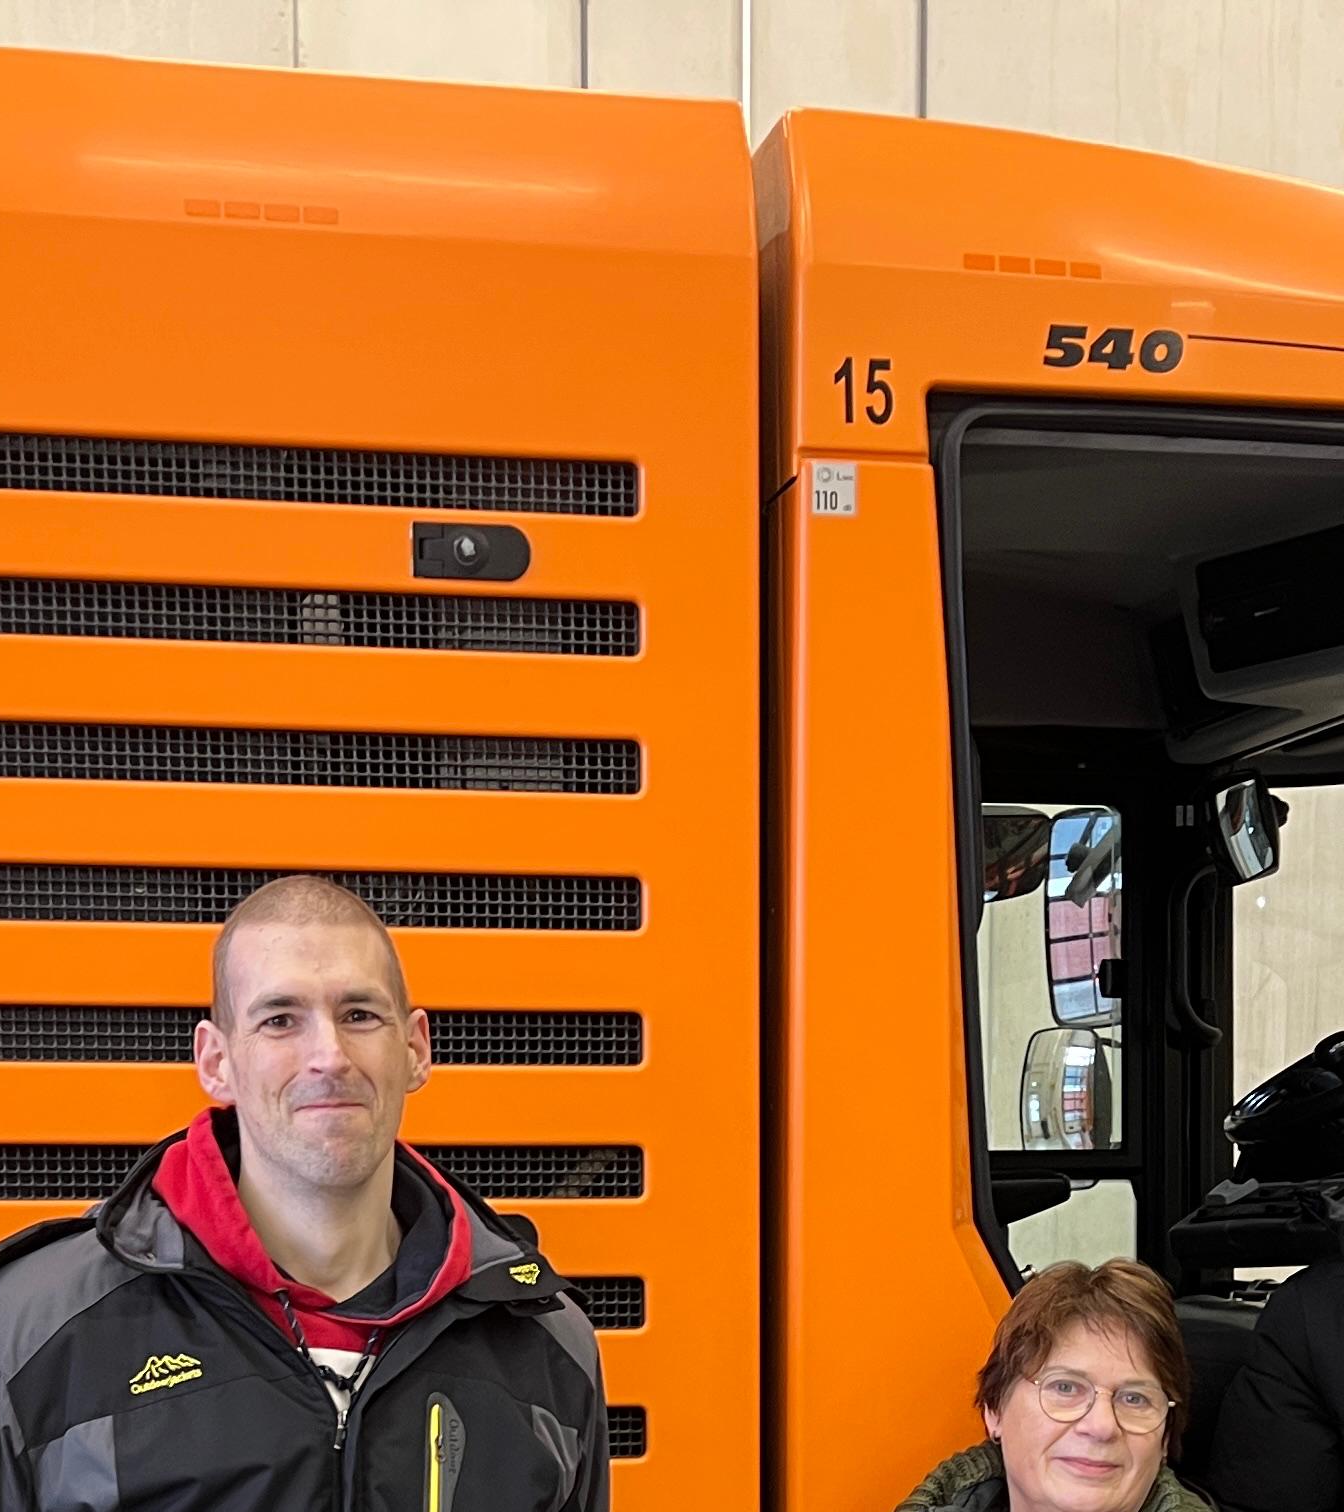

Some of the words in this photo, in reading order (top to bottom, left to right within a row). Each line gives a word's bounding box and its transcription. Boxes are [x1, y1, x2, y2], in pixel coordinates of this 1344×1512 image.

[1043, 324, 1184, 374] 540
[833, 356, 894, 425] 15
[814, 490, 839, 511] 110
